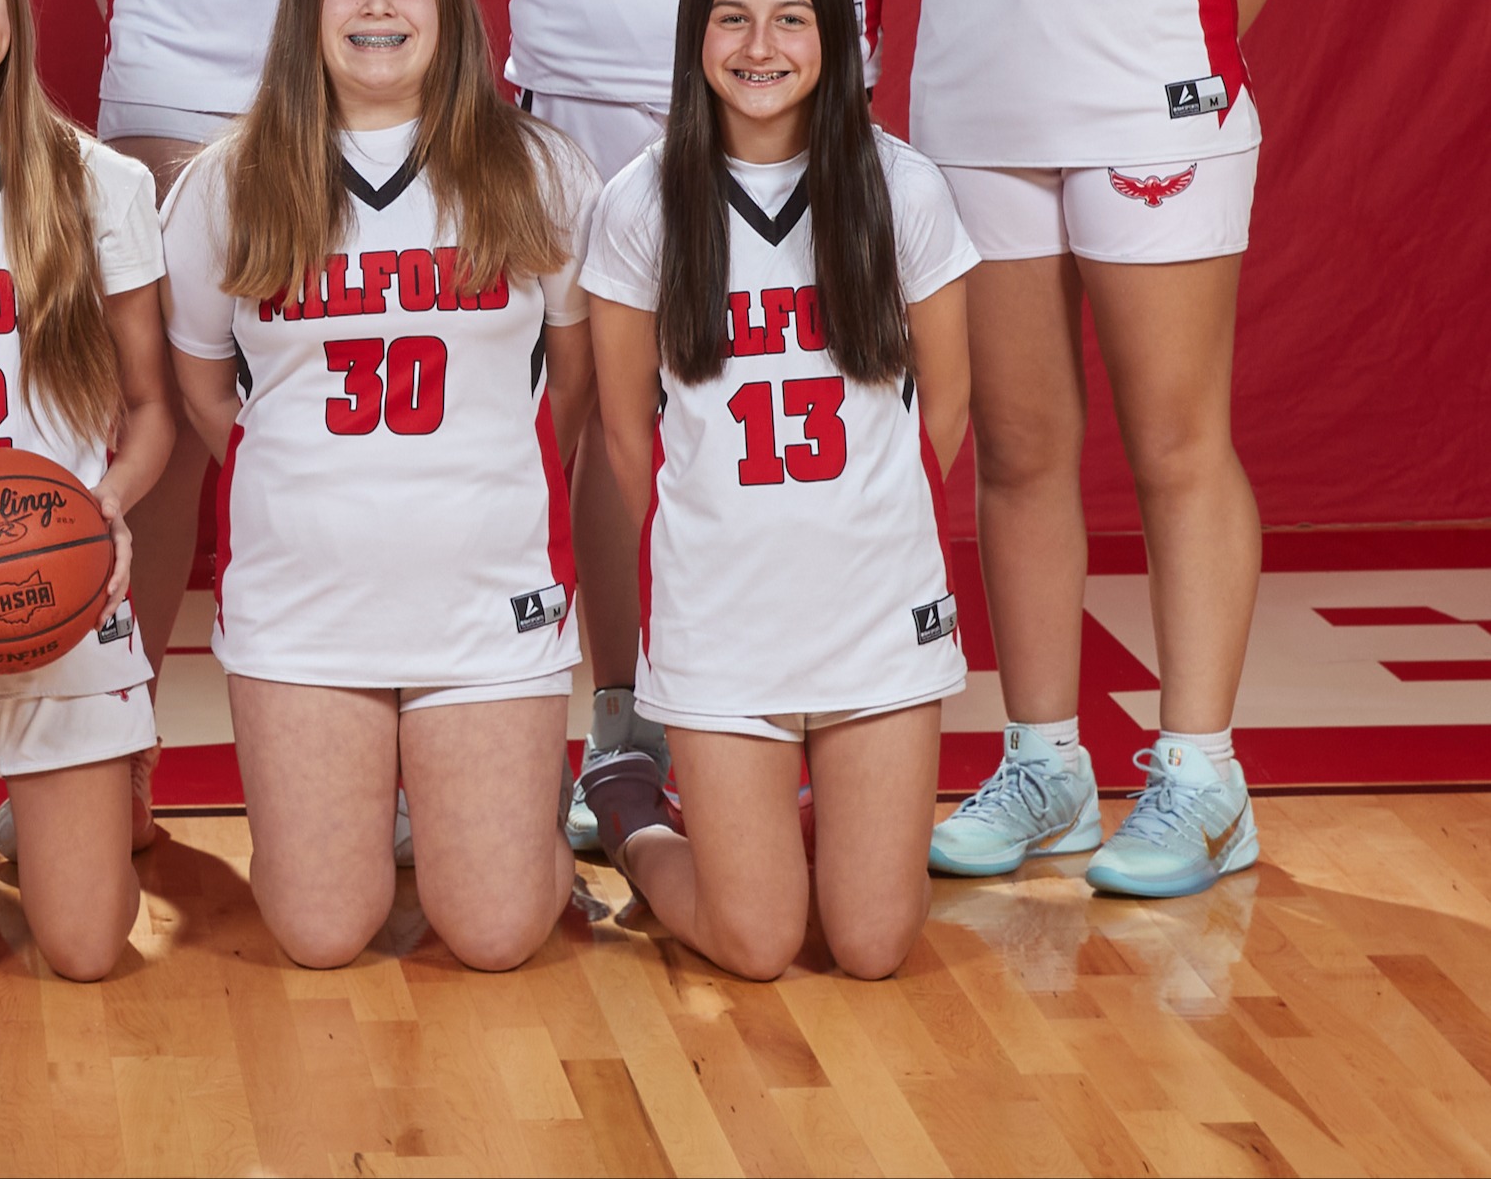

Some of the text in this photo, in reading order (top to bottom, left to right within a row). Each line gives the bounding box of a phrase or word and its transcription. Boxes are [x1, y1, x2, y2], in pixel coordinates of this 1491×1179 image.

[1209, 96, 1219, 108] M
[323, 335, 448, 435] 30
[727, 376, 847, 486] 13
[553, 606, 562, 618] M
[6, 639, 59, 663] NFHS
